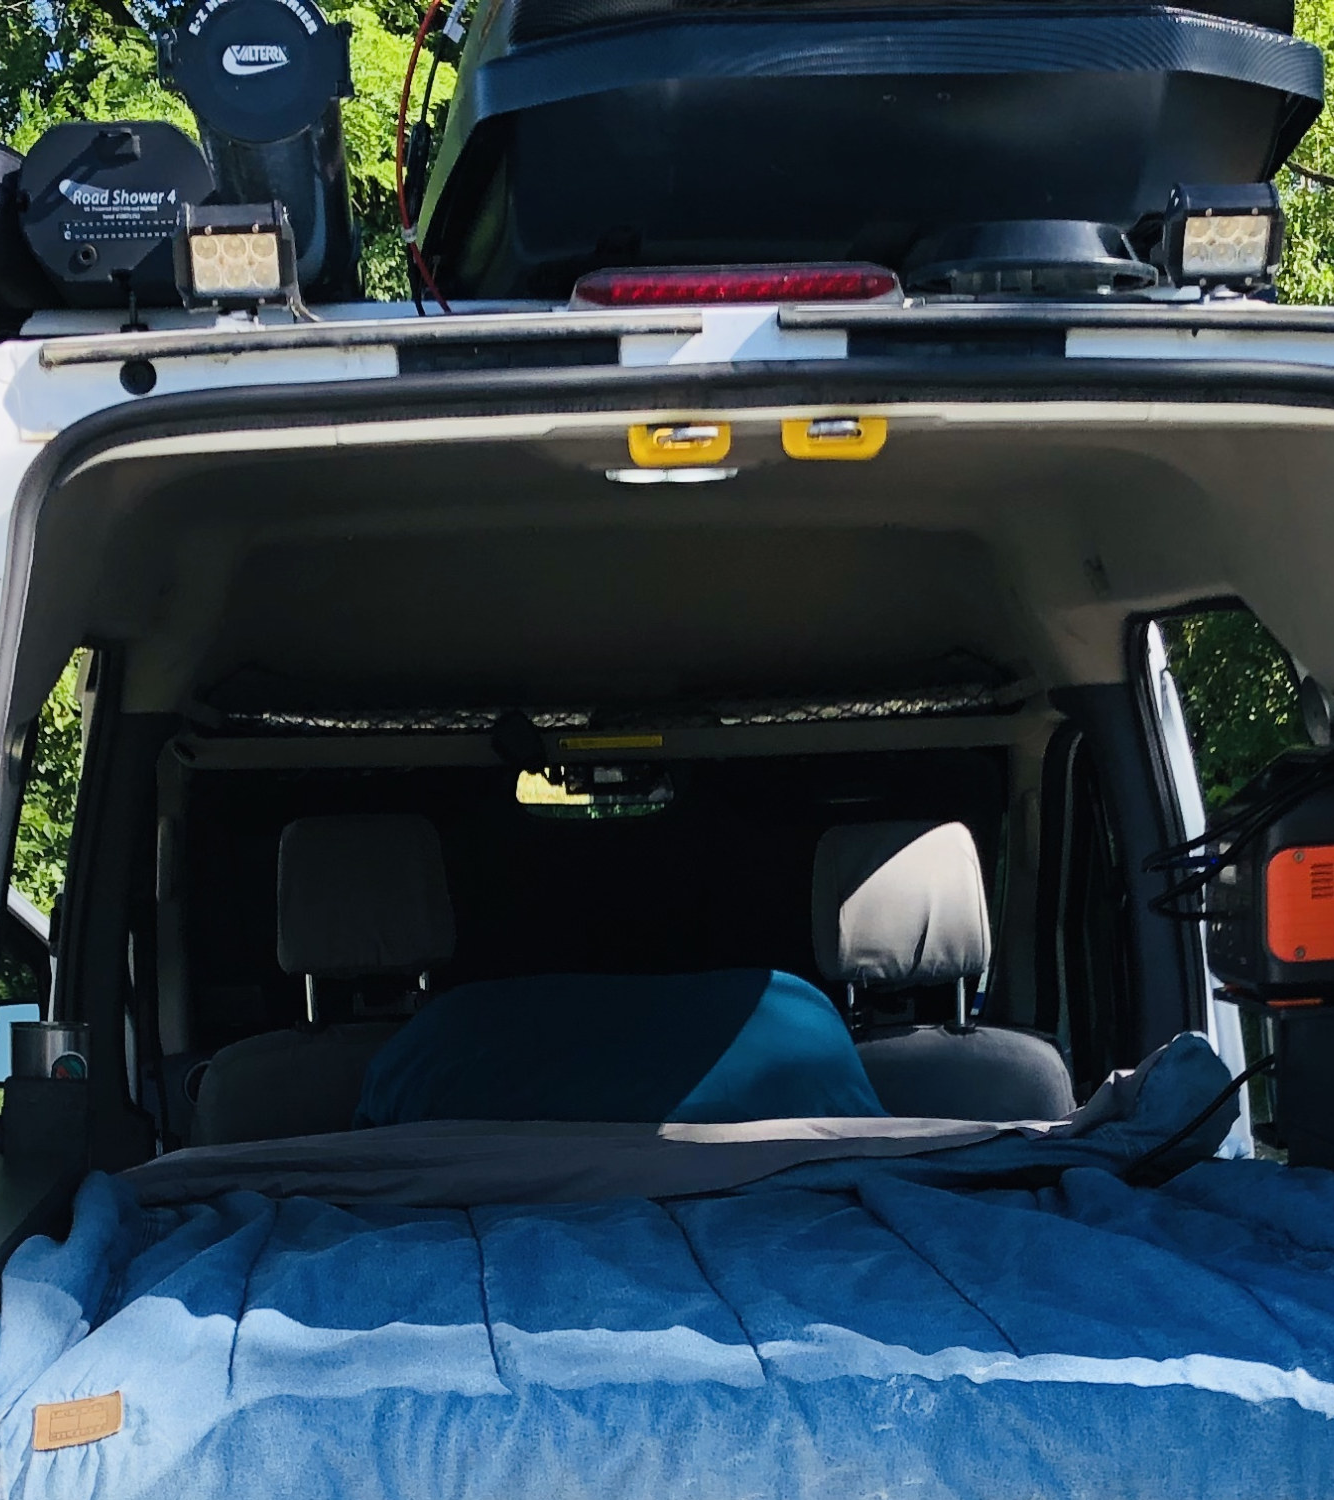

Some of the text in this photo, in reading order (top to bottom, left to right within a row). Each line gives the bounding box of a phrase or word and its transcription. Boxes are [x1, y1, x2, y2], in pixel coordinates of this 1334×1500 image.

[230, 44, 287, 62] VALTERRA
[72, 189, 177, 205] Road Shower 4
